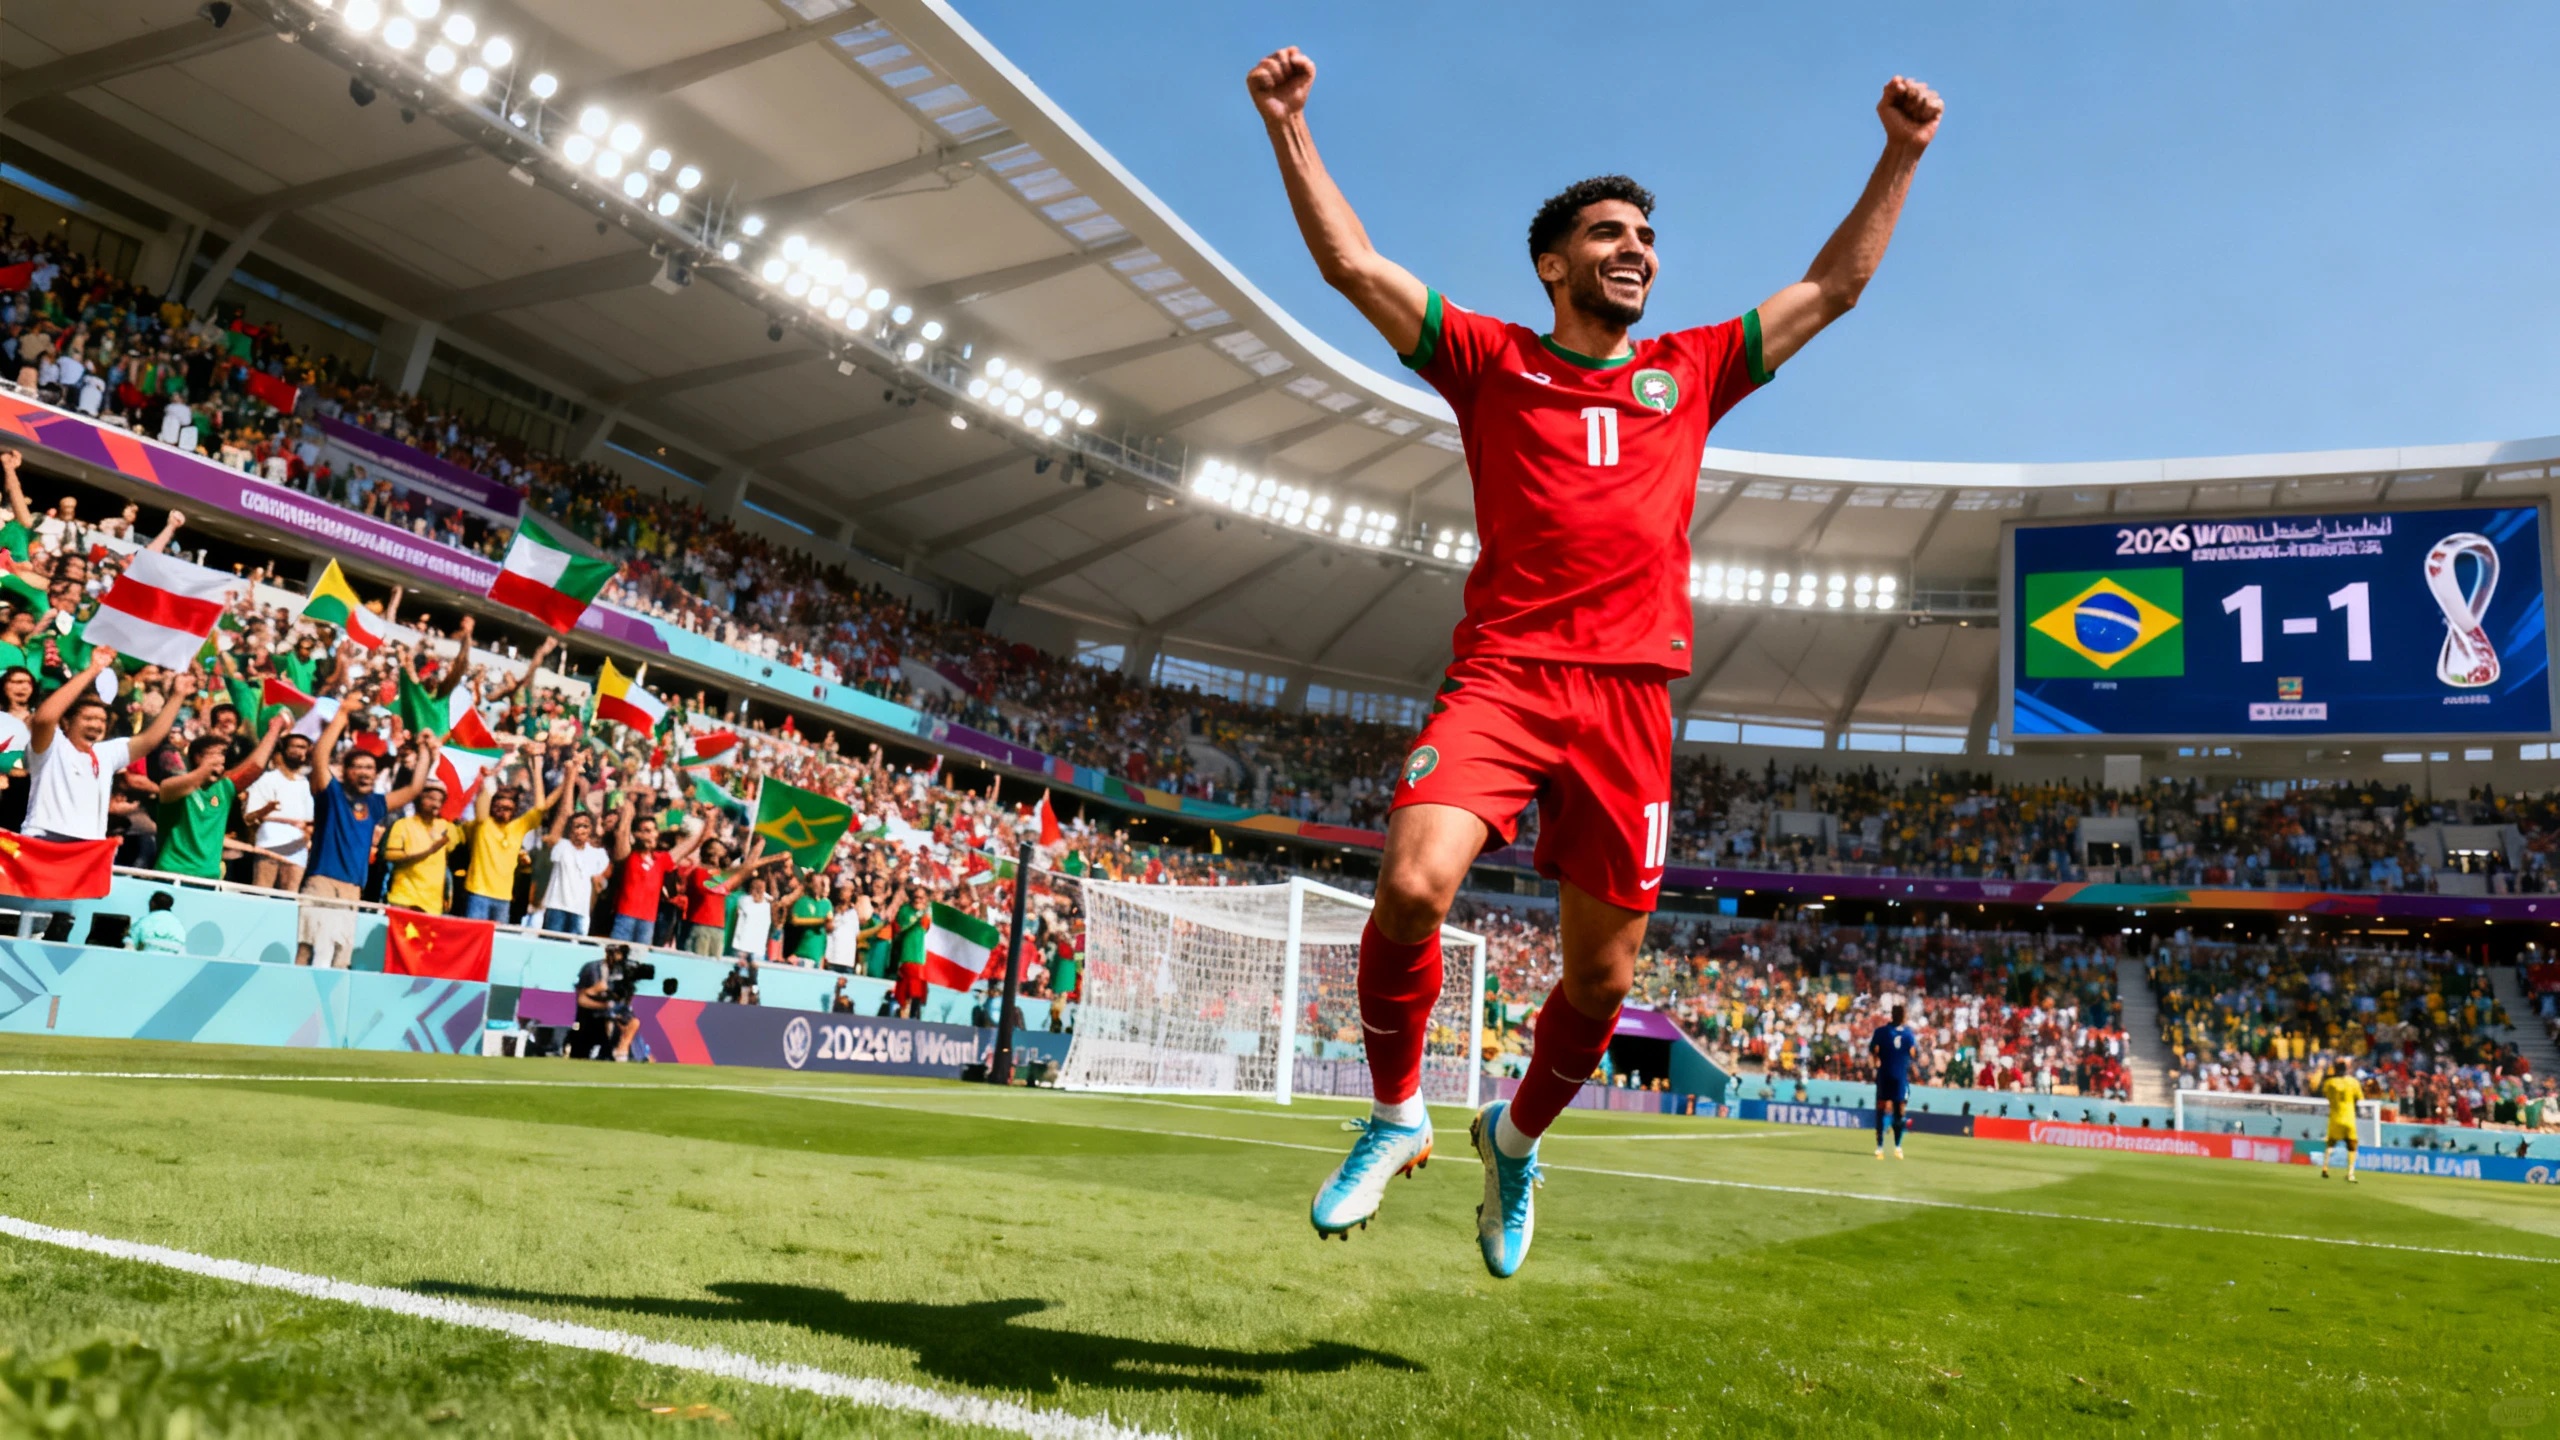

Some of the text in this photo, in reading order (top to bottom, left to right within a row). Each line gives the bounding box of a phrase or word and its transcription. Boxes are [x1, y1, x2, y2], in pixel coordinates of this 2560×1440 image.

[1580, 406, 1620, 467] 11
[2115, 523, 2191, 556] 2026
[1643, 800, 1670, 869] 11
